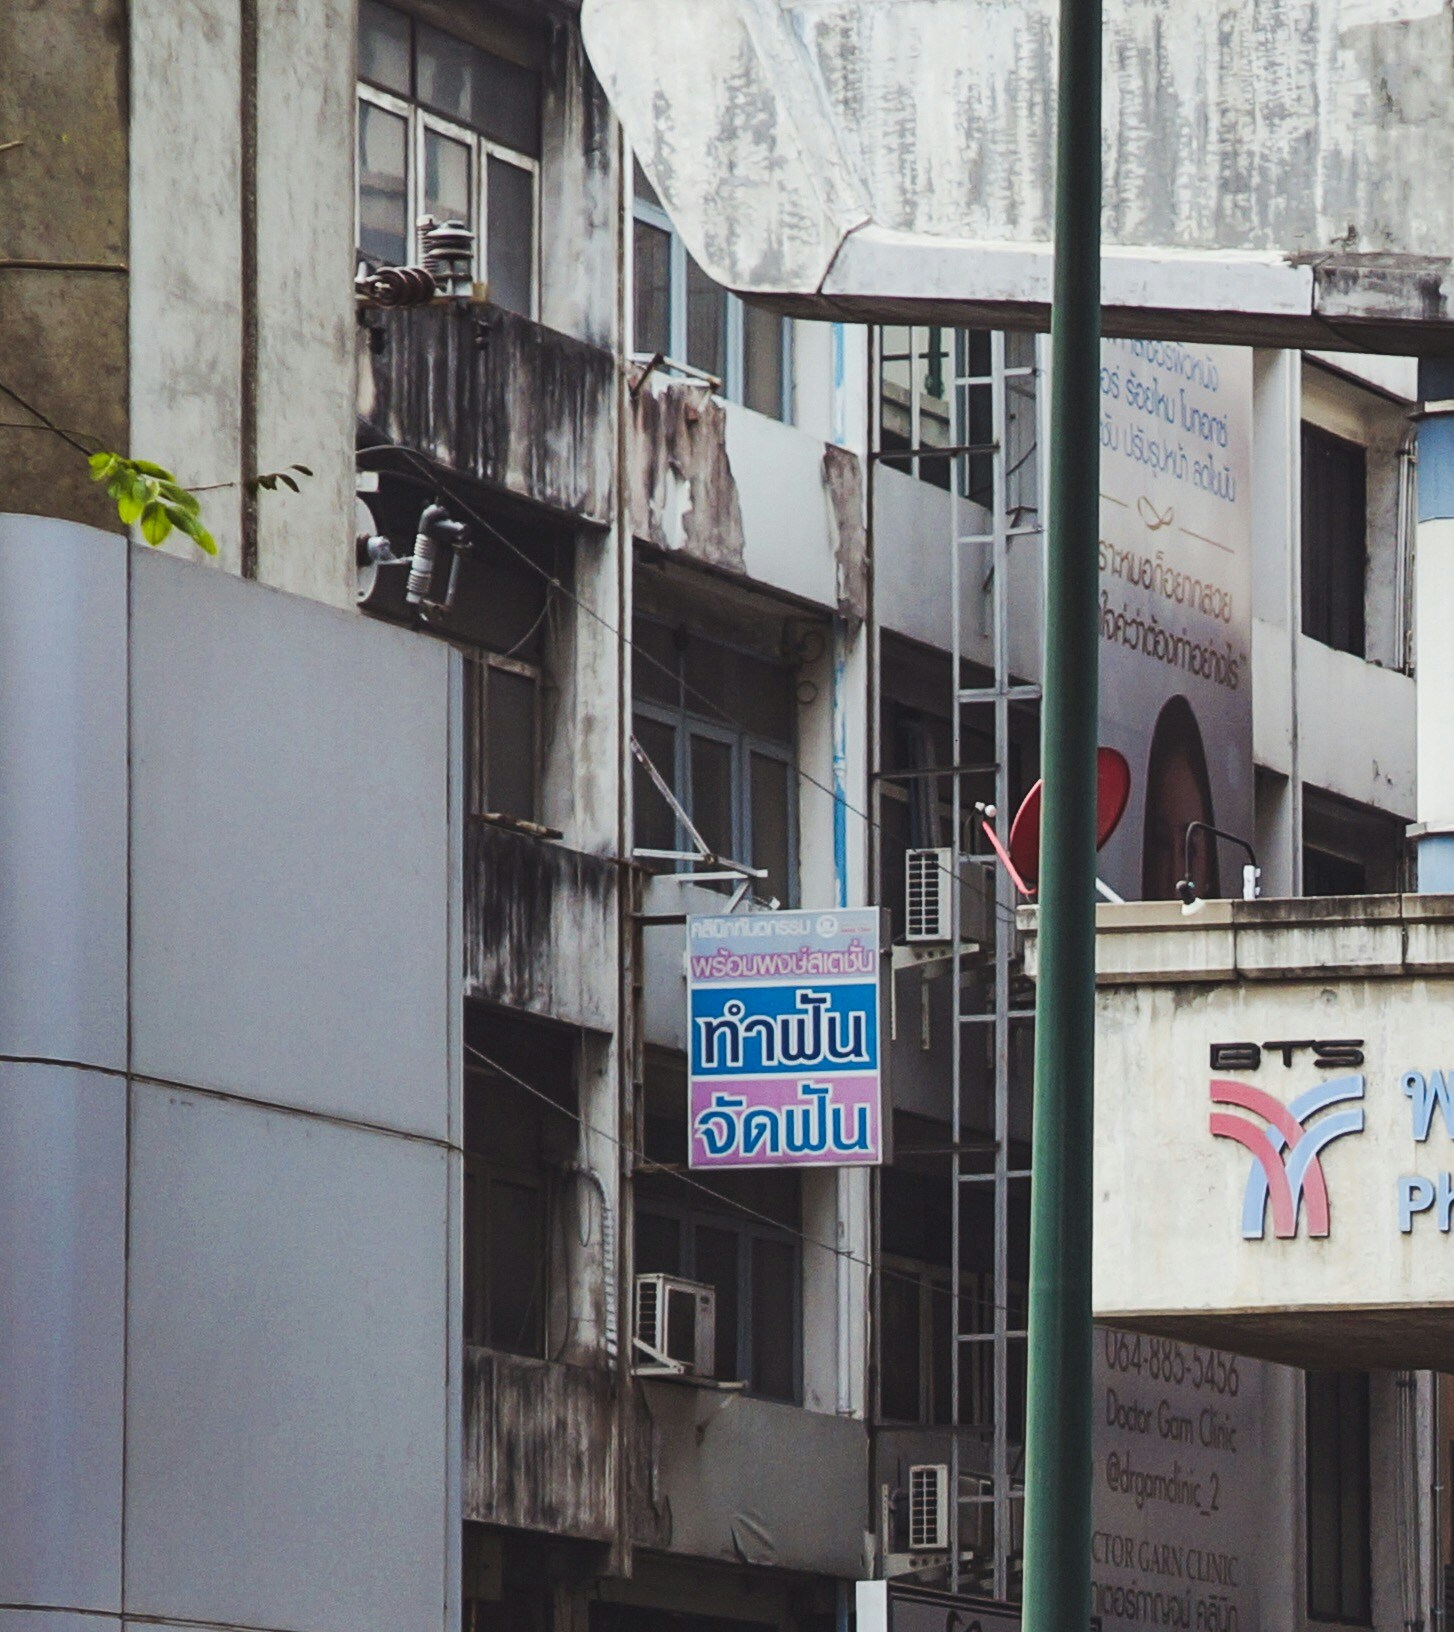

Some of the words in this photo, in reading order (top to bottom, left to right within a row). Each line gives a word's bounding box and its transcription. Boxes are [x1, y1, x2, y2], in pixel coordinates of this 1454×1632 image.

[696, 989, 870, 1068] ทำฟัน
[1209, 1038, 1365, 1070] BTS
[696, 1080, 874, 1157] จัดฟัน
[1091, 1530, 1136, 1568] CTOR
